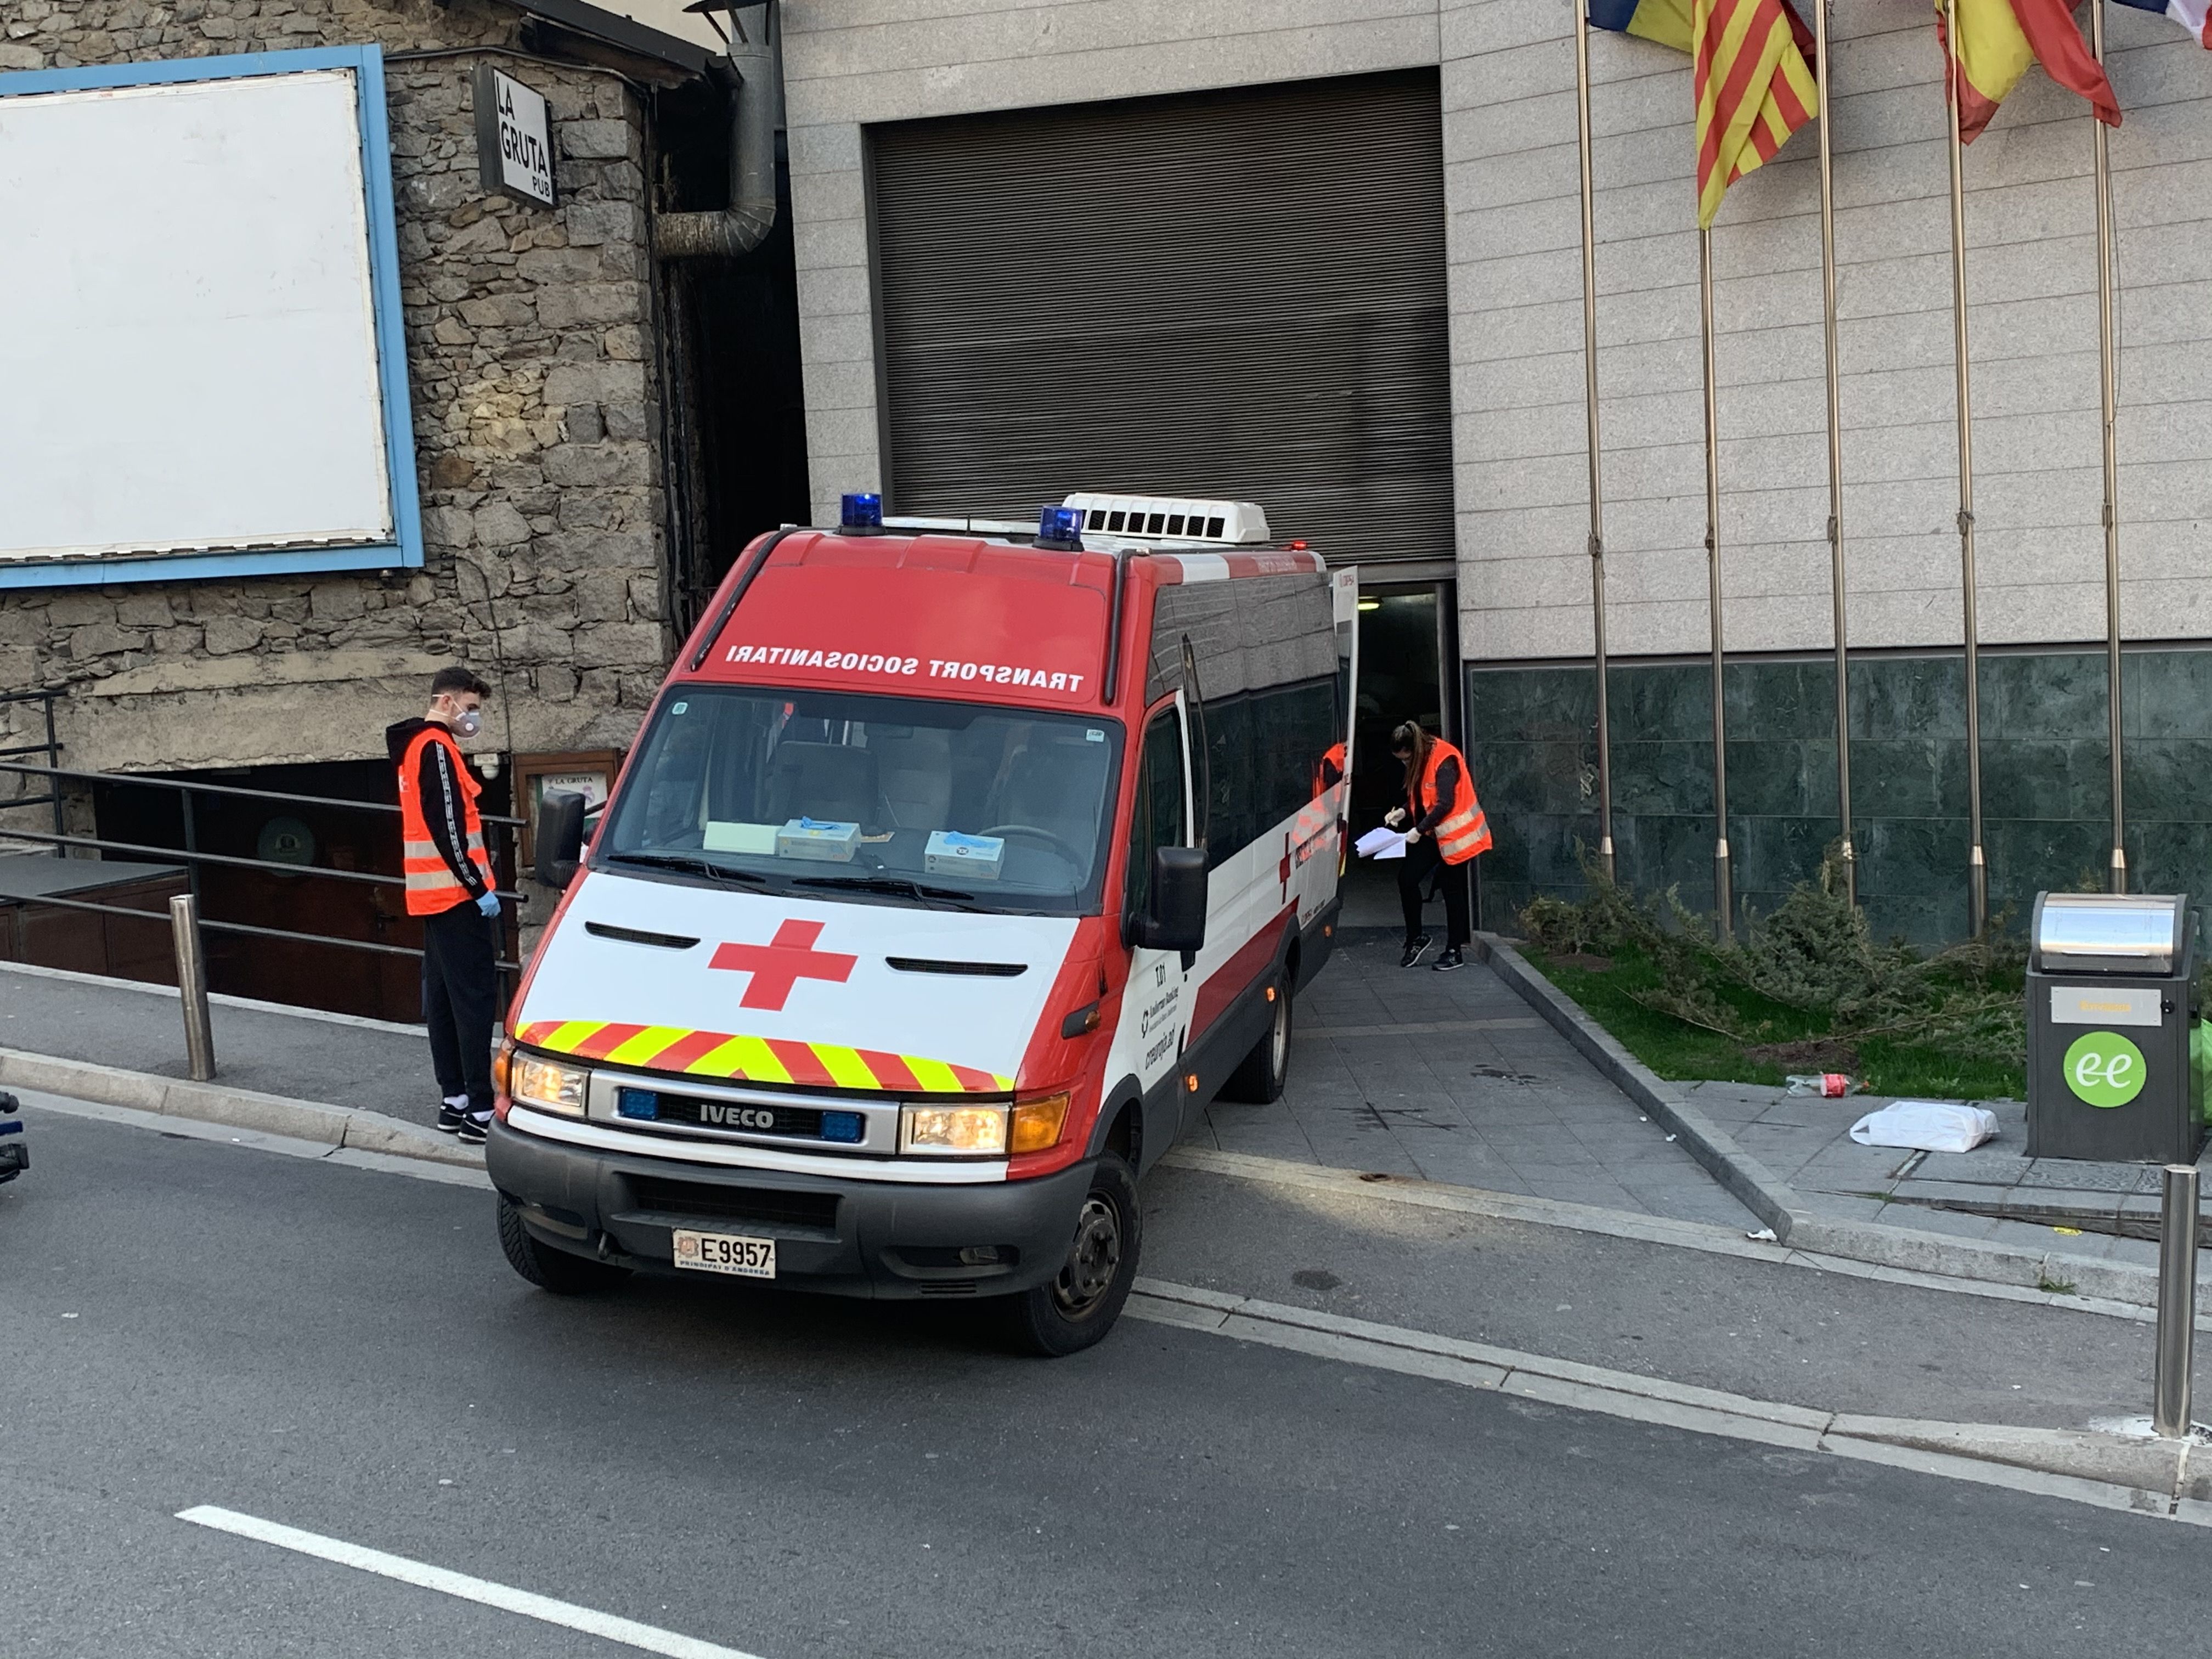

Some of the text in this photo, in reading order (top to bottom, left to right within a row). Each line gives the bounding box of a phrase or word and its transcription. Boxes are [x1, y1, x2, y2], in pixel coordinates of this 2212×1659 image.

[496, 76, 516, 121] LA
[501, 121, 548, 177] GRUTA
[532, 176, 550, 198] PUB
[2075, 1052, 2132, 1088] ee
[700, 1104, 774, 1128] IVECO
[701, 1238, 771, 1268] E9957
